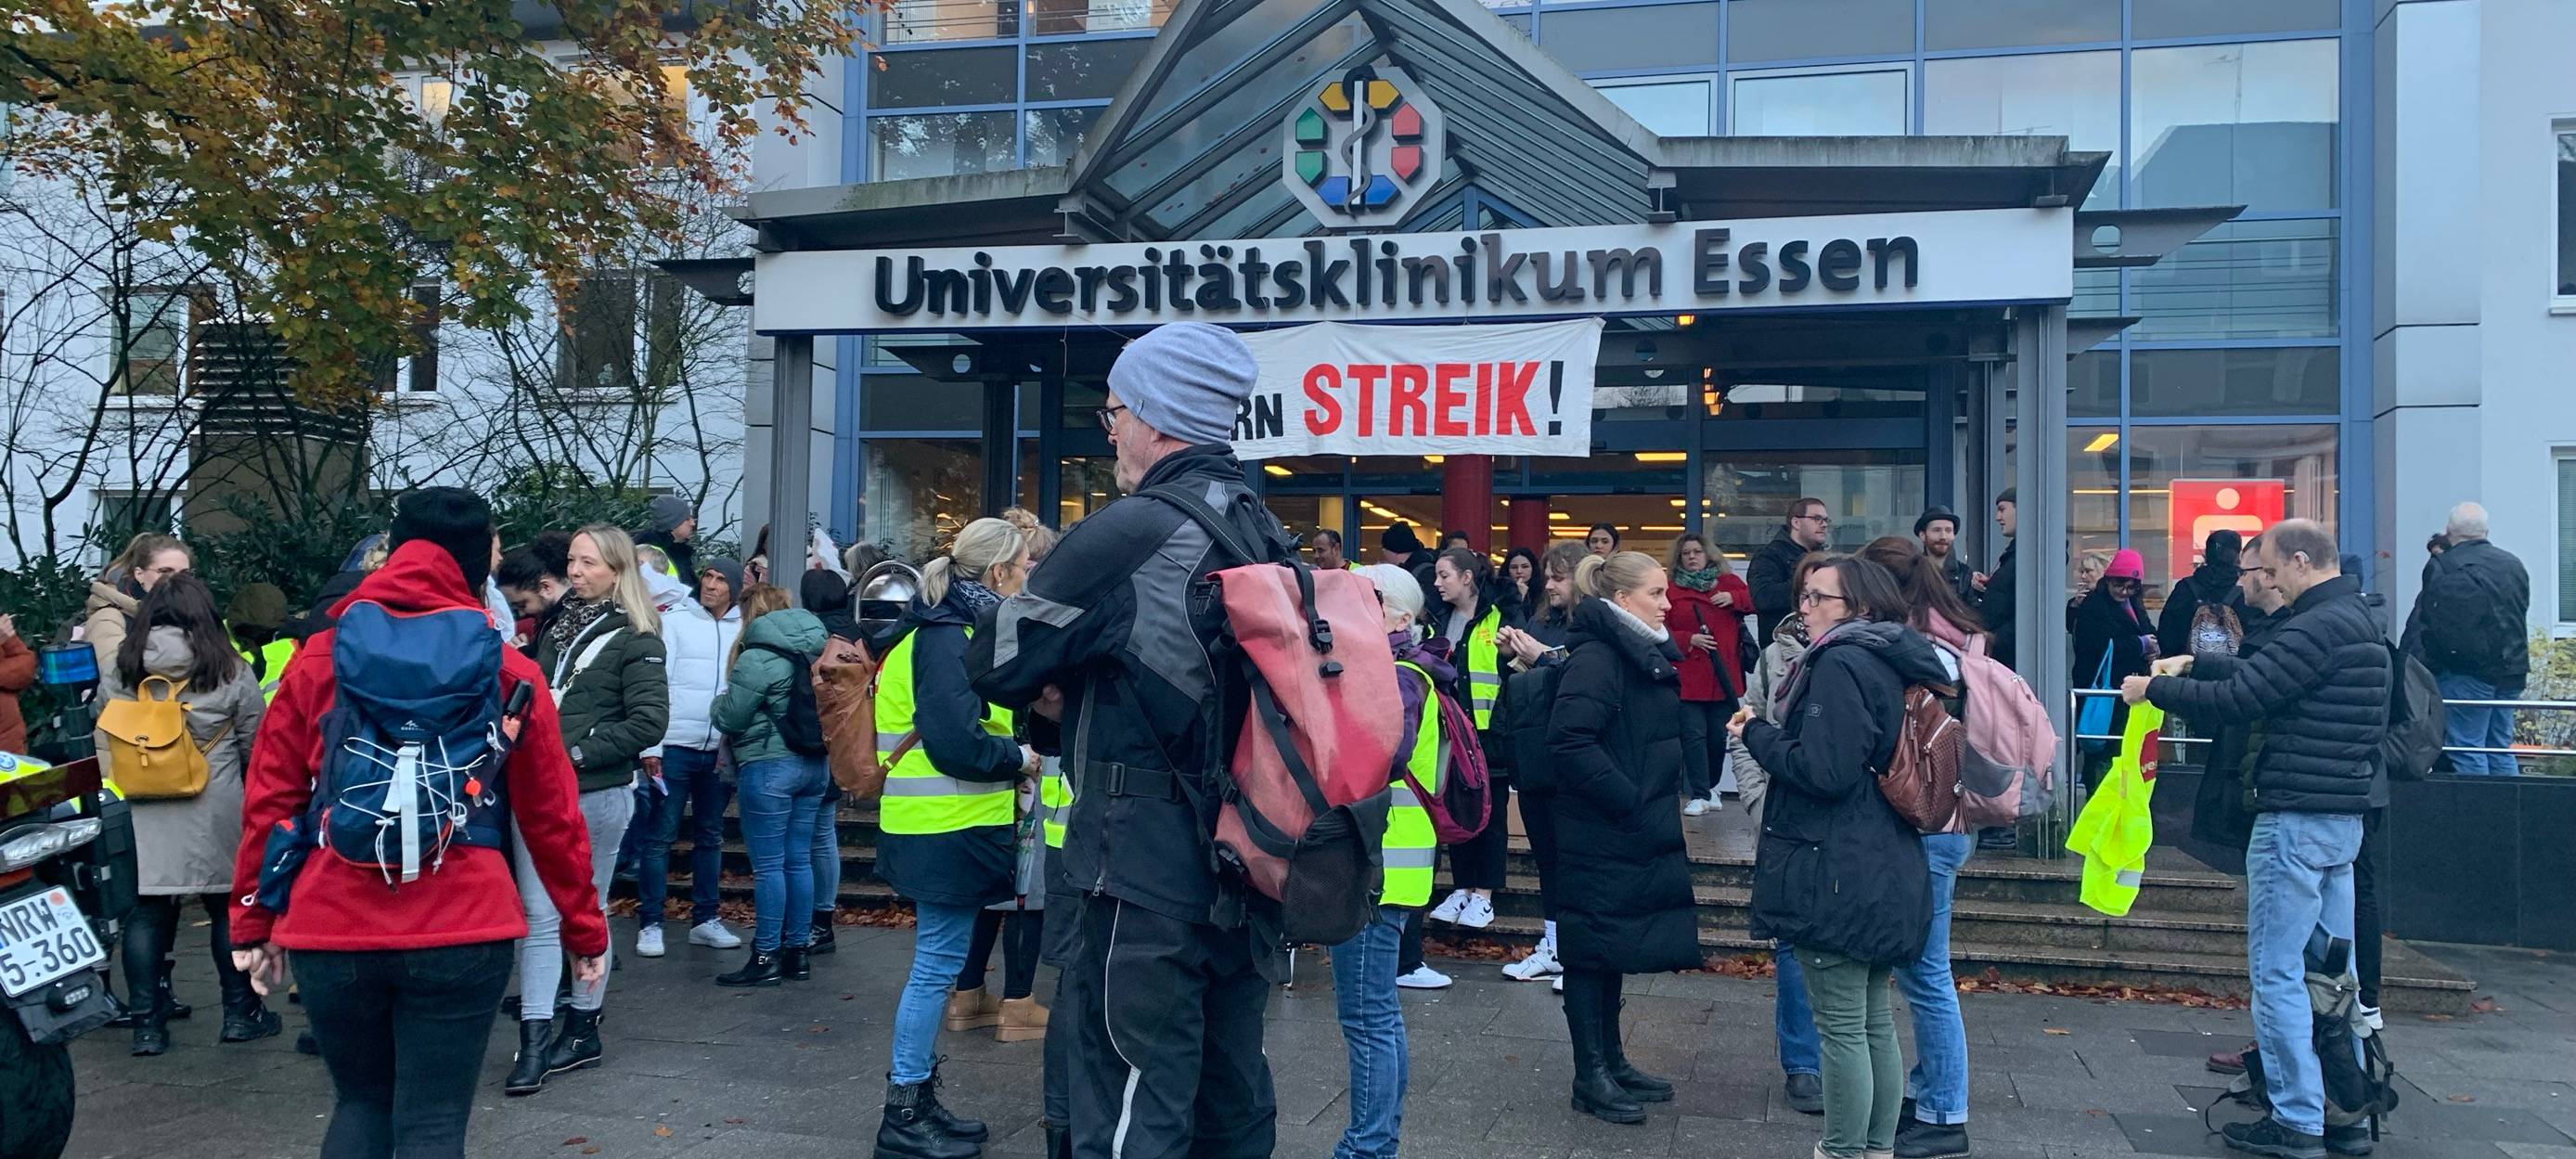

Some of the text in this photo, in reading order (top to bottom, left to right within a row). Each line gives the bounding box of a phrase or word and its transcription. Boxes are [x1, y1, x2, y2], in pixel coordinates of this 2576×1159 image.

[875, 228, 1919, 316] Universitätsklinikum Essen
[1303, 360, 1564, 437] STREIK!
[0, 897, 58, 947] NRW
